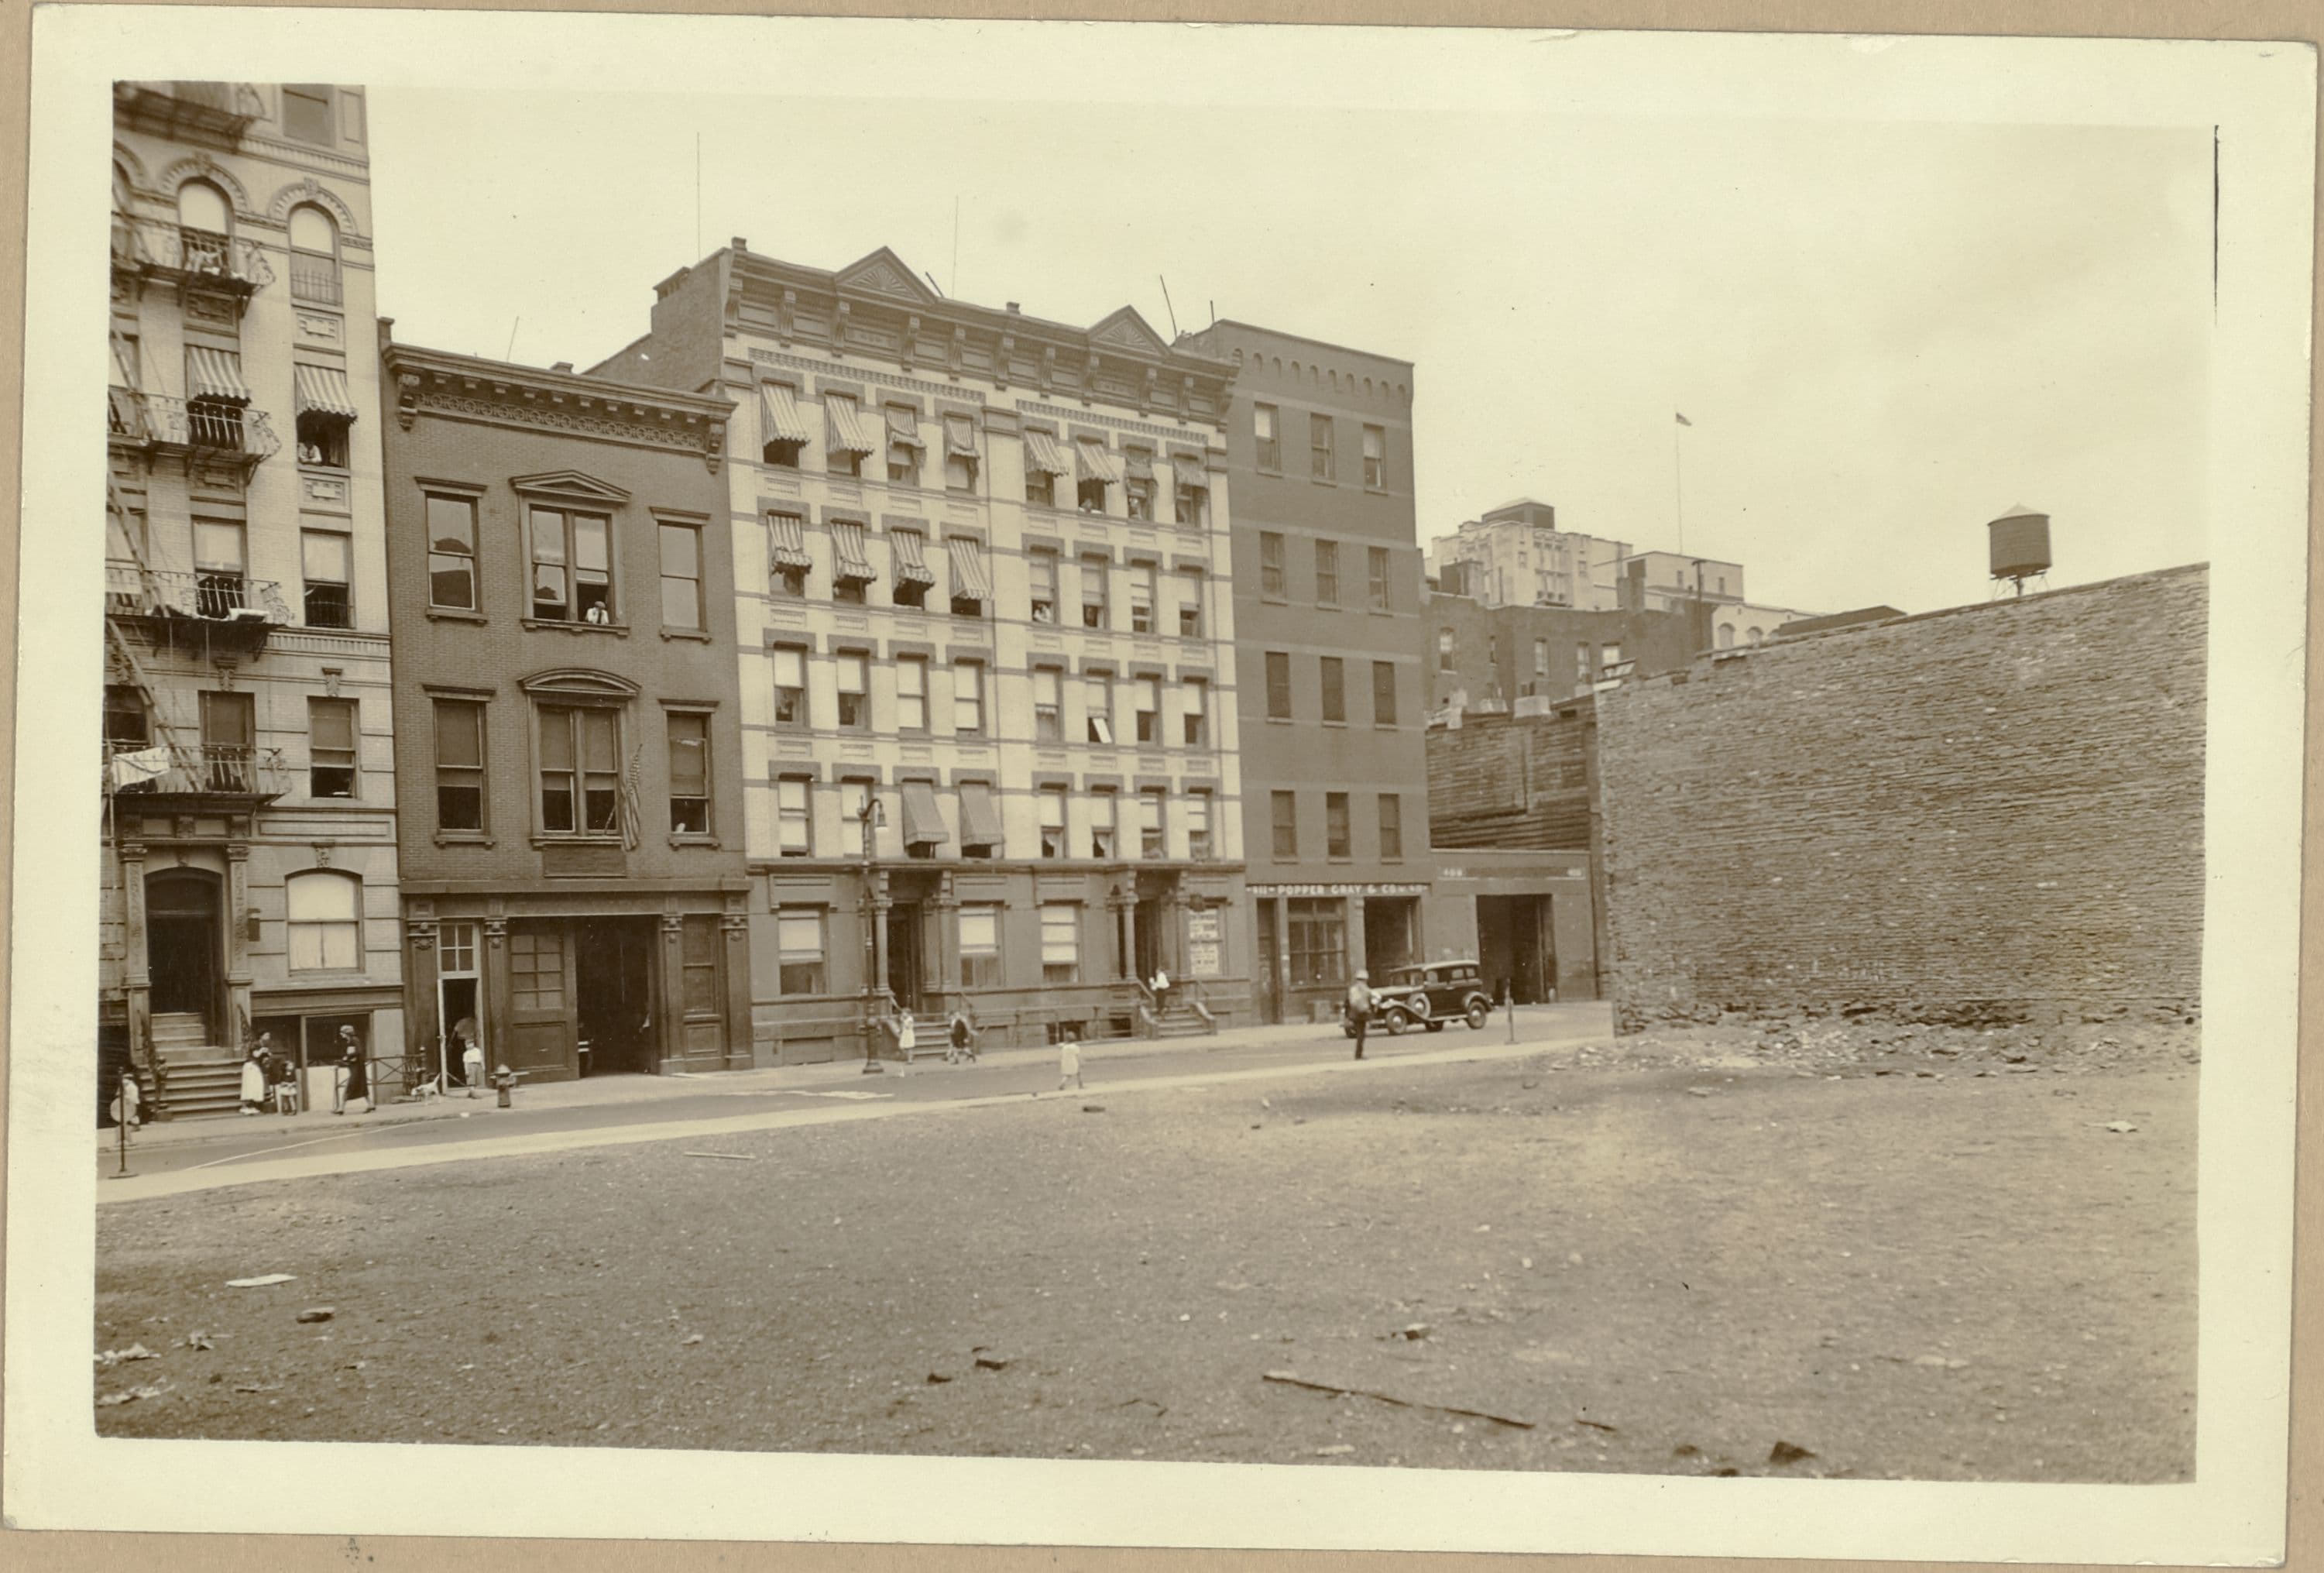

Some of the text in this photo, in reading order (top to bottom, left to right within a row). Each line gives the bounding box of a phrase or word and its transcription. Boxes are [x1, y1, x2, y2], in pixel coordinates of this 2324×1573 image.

[1277, 884, 1324, 895] POPPER
[1330, 884, 1362, 895] GRAY
[1367, 884, 1377, 894] &
